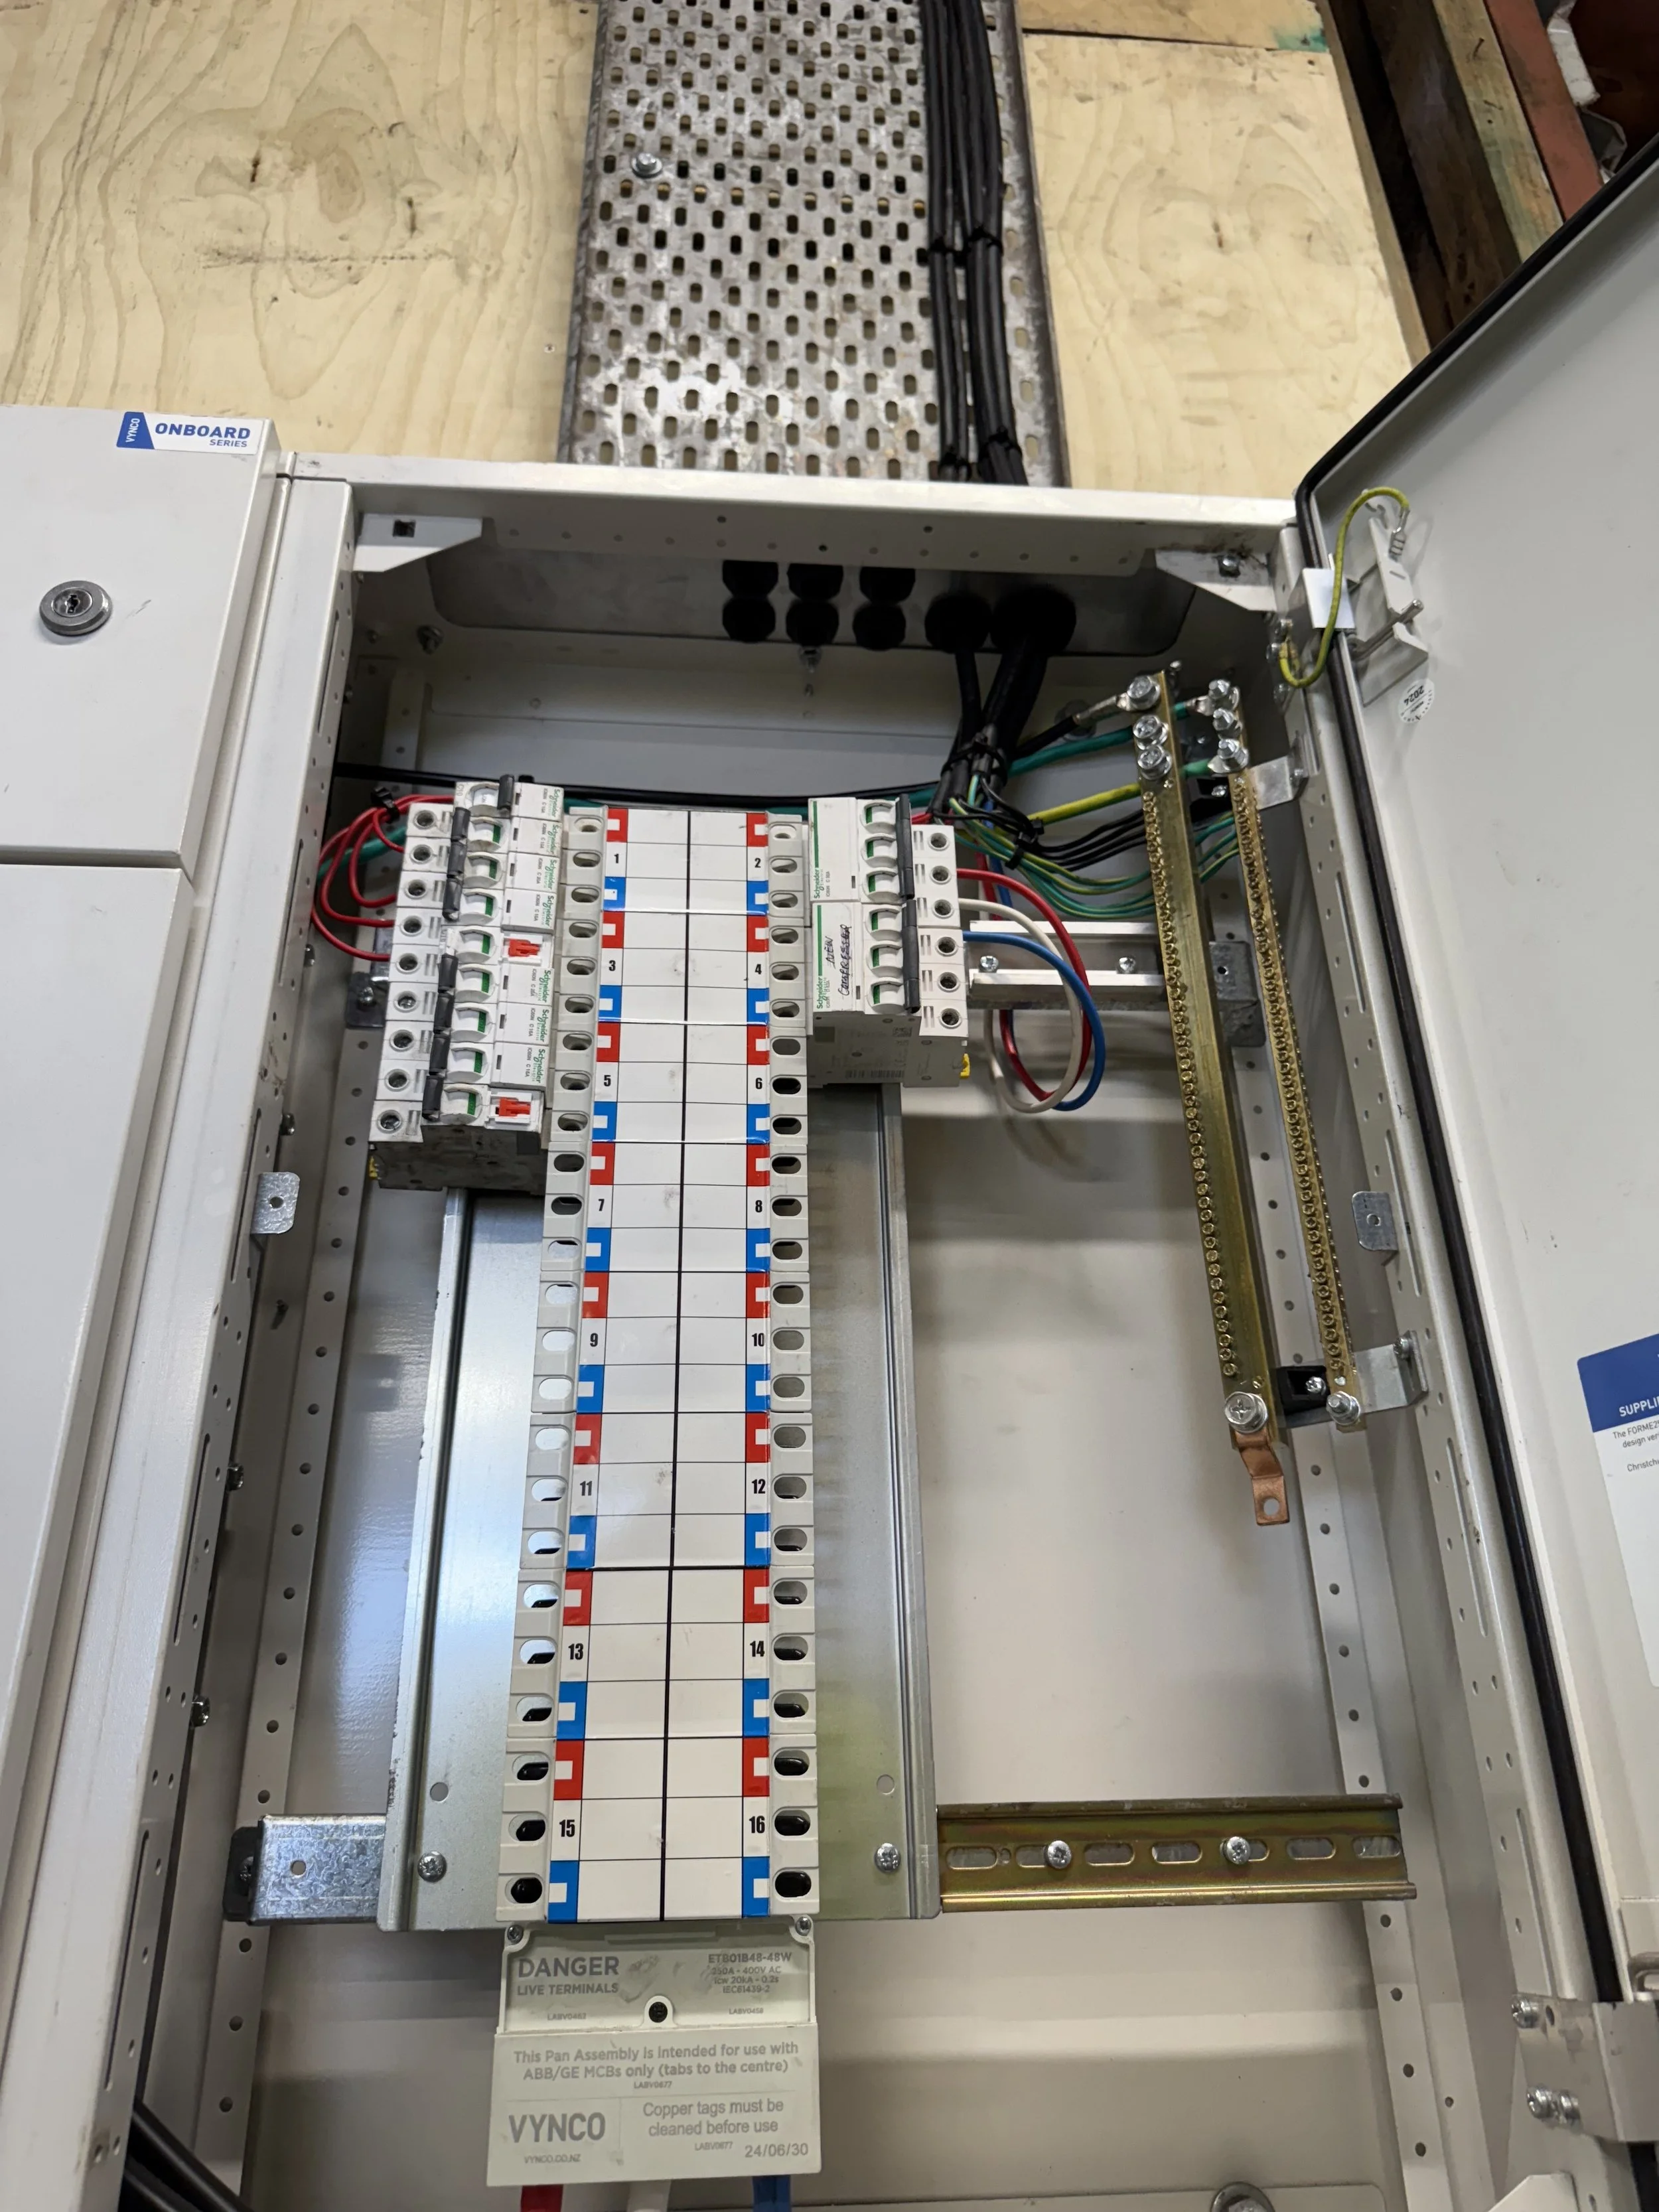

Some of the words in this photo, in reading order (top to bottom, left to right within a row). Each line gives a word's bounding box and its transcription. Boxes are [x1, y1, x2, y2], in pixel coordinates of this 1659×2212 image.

[125, 417, 141, 443] VYNCO
[155, 423, 251, 439] ONBOARD
[209, 439, 248, 447] SERIES
[549, 788, 561, 817] Schneider
[547, 824, 559, 854] Schneider
[614, 853, 619, 864] 1
[755, 857, 761, 868] 2
[545, 859, 557, 890] Schneider
[814, 869, 825, 899] Schneider
[542, 895, 554, 926] Schneider
[609, 960, 616, 972] 3
[755, 964, 762, 975] 4
[539, 970, 551, 1003] Schneider
[816, 977, 828, 1009] Schneider
[537, 1009, 549, 1043] Schneider
[533, 1049, 545, 1084] Schneider
[603, 1074, 611, 1087] 5
[755, 1077, 763, 1090] 6
[598, 1198, 605, 1212] 7
[755, 1199, 763, 1213] 8
[589, 1333, 599, 1347] 9
[751, 1332, 764, 1347] 10
[1613, 1431, 1626, 1439] The
[1623, 1437, 1646, 1448] design
[579, 1481, 593, 1497] 11
[751, 1478, 766, 1495] 12
[567, 1643, 584, 1660] 13
[749, 1640, 765, 1658] 14
[559, 1819, 575, 1838] 15
[749, 1815, 765, 1834] 16
[518, 1956, 620, 1978] DANGER
[731, 1975, 753, 1984] 20kA
[516, 1984, 545, 1996] LIVE
[548, 1982, 620, 1995] TERMINALS
[514, 2050, 541, 2063] This
[545, 2049, 570, 2062] Pan
[573, 2047, 639, 2061] Assembly
[721, 2043, 740, 2056] for
[743, 2045, 766, 2055] use
[770, 2041, 798, 2055] with
[523, 2065, 579, 2081] ABB/GE
[584, 2065, 622, 2078] MCBs
[625, 2064, 654, 2078] only
[658, 2063, 693, 2077] (tabs
[697, 2063, 711, 2075] to
[715, 2061, 737, 2073] the
[740, 2059, 788, 2073] centre)
[643, 2102, 693, 2119] Copper
[697, 2101, 726, 2117] tags
[729, 2099, 763, 2114] must
[766, 2099, 784, 2112] be
[508, 2112, 606, 2143] VYNCO
[648, 2120, 702, 2136] cleaned
[707, 2119, 749, 2134] before
[754, 2120, 778, 2132] use
[745, 2142, 809, 2158] 24/06/30
[524, 2154, 581, 2164] VYNCO.CO.NZ
